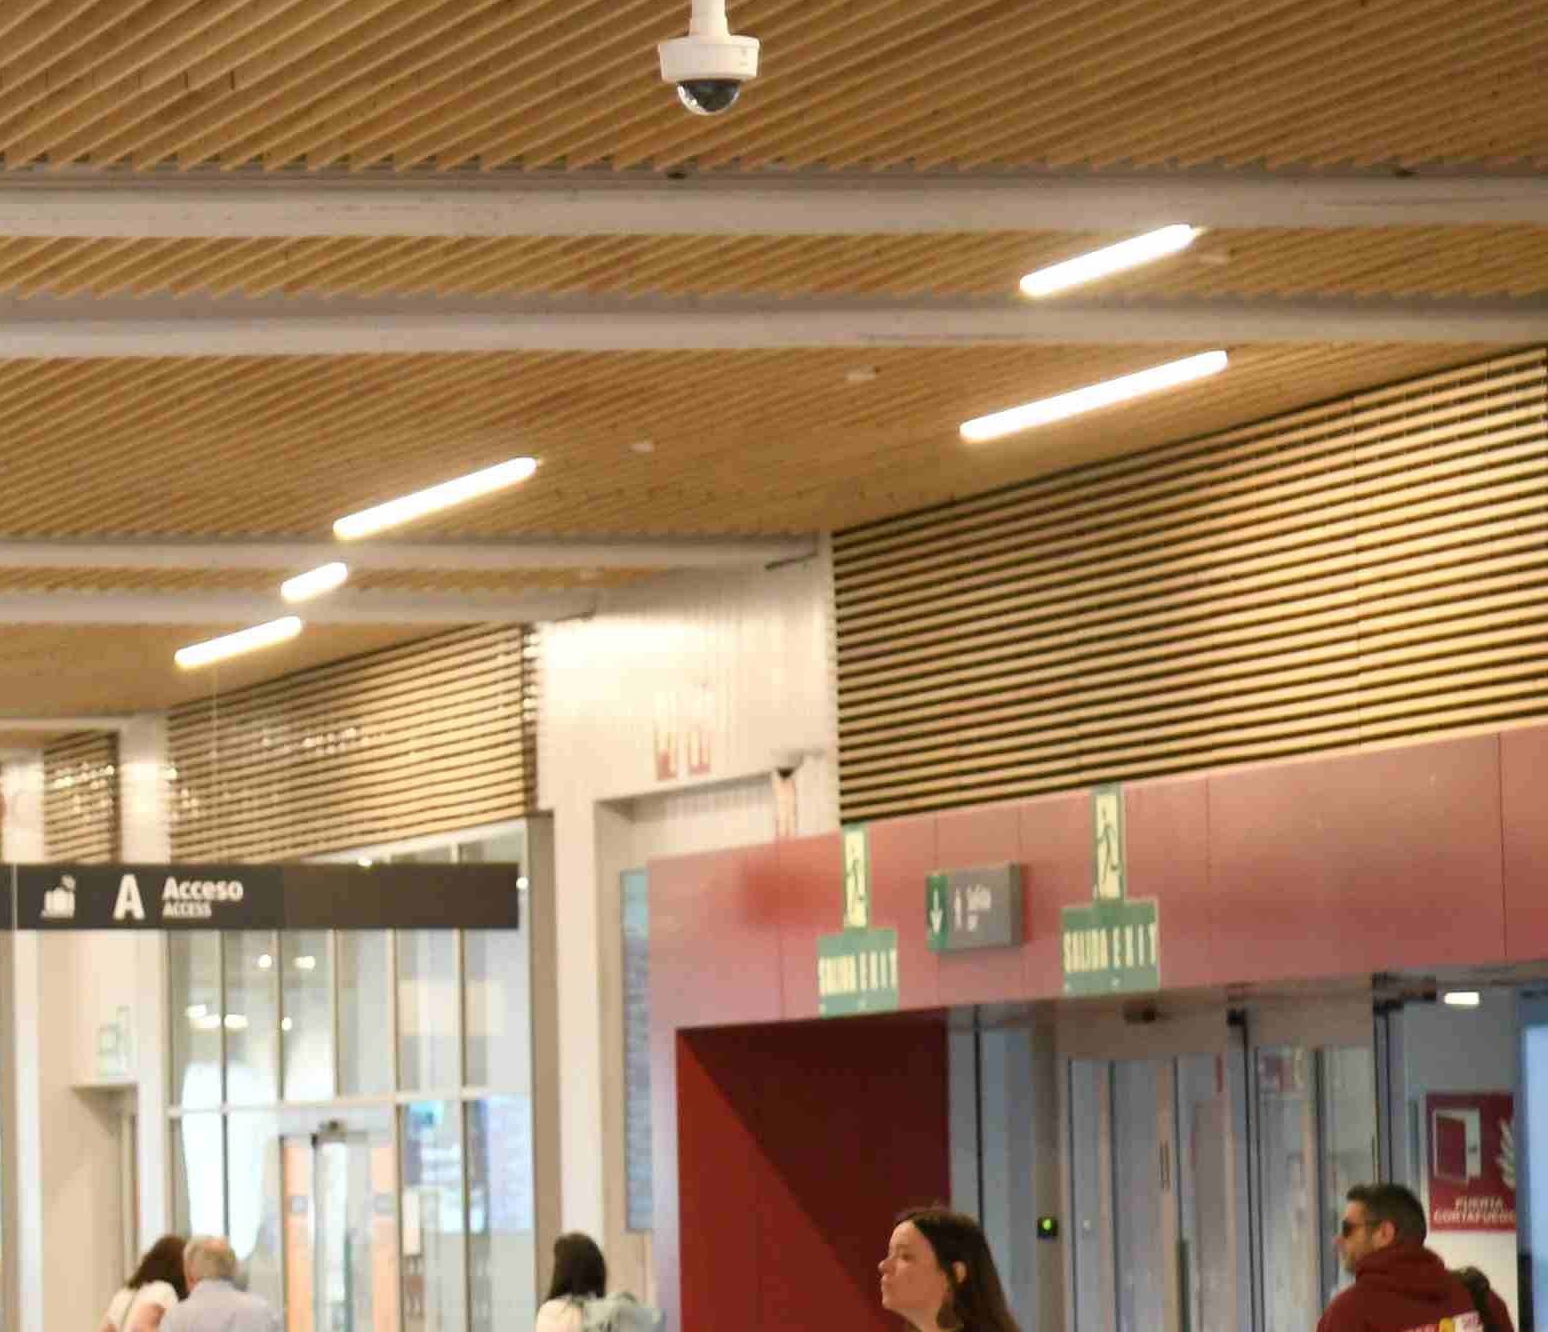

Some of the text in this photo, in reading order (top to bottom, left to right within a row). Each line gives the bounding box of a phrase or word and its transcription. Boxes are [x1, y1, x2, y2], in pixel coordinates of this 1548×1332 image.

[113, 874, 145, 920] A
[161, 876, 244, 902] Acceso
[162, 902, 212, 918] ACCESS
[1112, 920, 1158, 968] EXIT
[859, 948, 898, 990] EXIT
